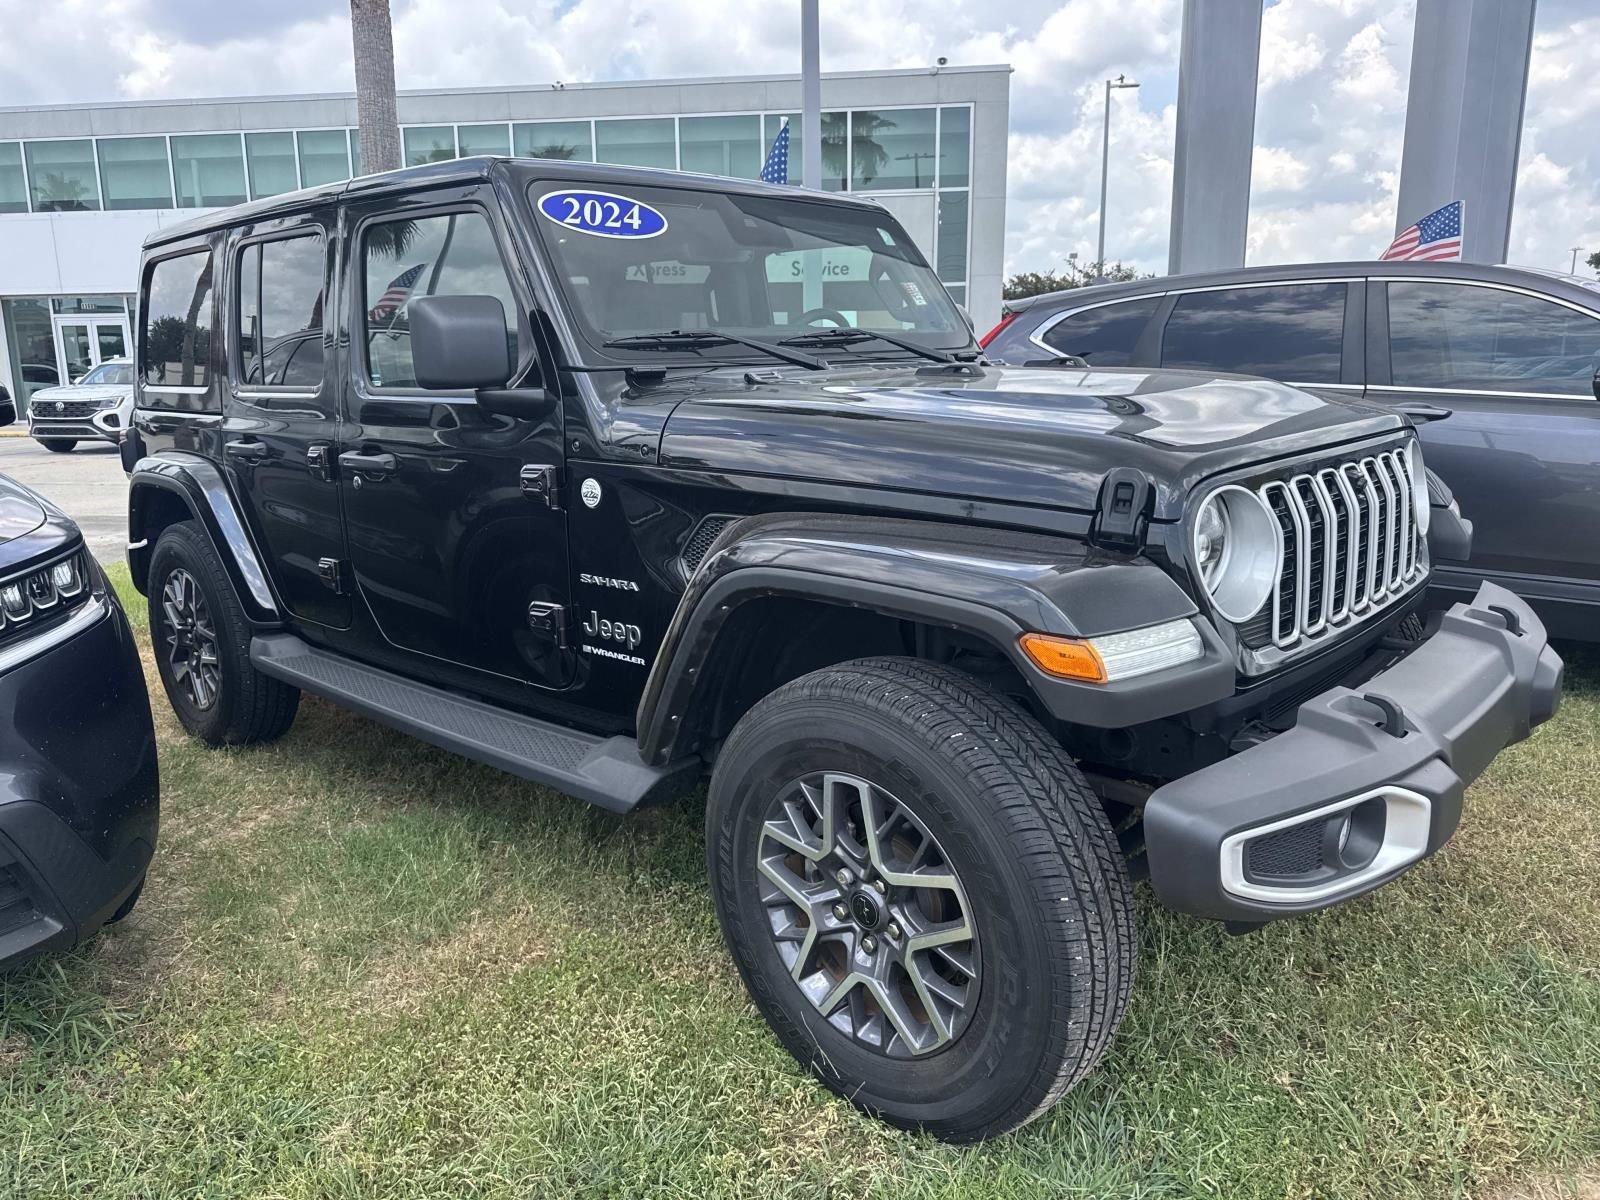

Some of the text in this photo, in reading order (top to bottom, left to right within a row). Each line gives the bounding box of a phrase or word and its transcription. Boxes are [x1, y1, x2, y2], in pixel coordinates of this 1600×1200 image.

[562, 197, 642, 230] 2024
[791, 260, 849, 277] Svice
[580, 573, 641, 592] SAHARA
[583, 610, 641, 650] Jeep
[591, 646, 646, 666] WRANGLER
